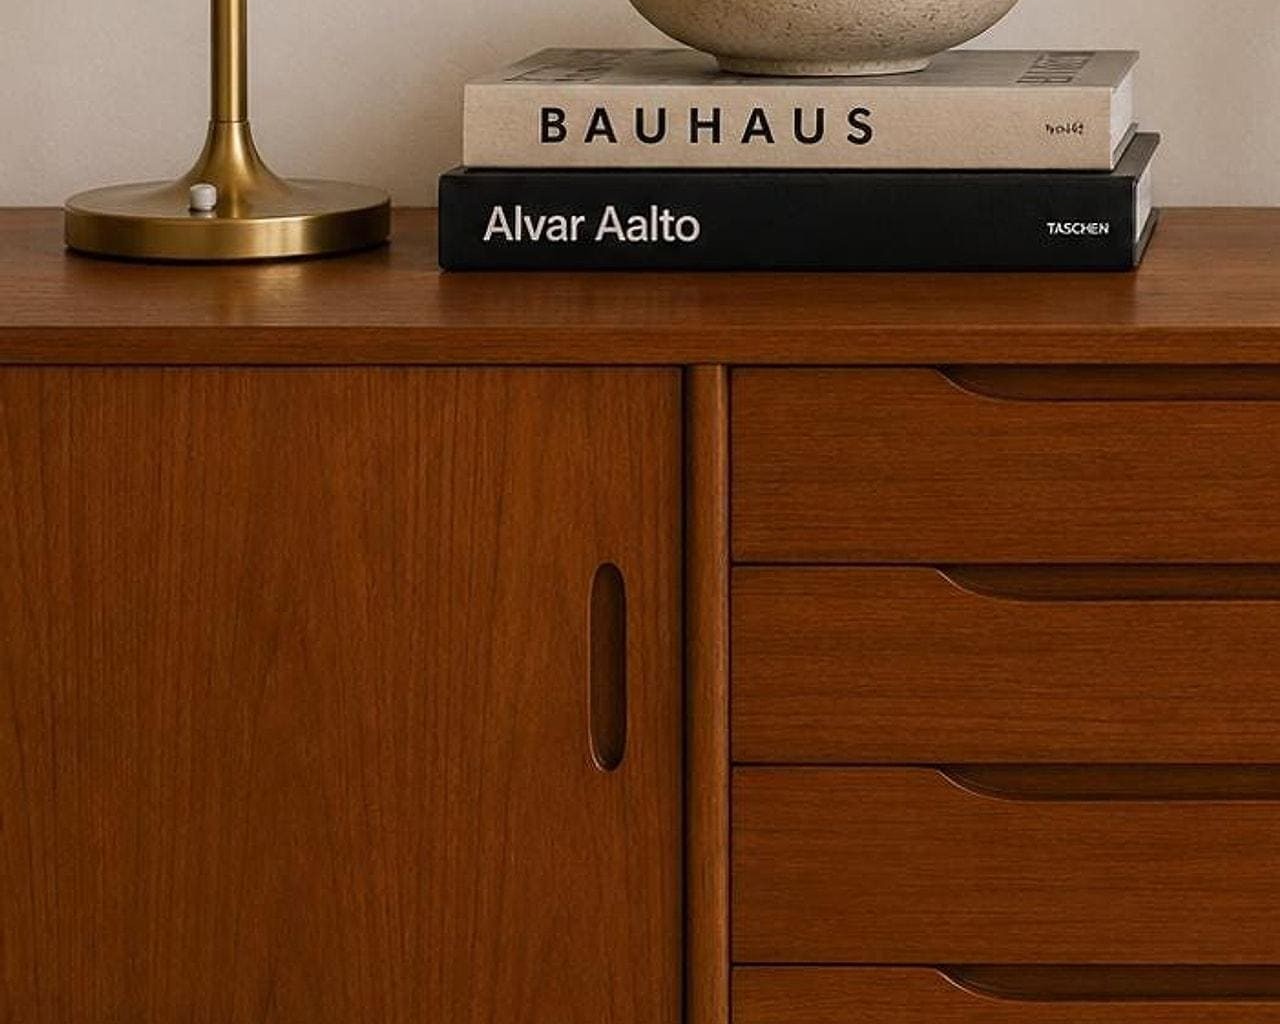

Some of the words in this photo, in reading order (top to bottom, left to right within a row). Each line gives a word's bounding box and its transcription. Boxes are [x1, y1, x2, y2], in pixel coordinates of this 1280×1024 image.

[540, 107, 873, 146] BAUHAUS
[483, 204, 586, 242] Alvar
[594, 204, 700, 242] Aalto
[1046, 222, 1110, 235] TASCHEN
